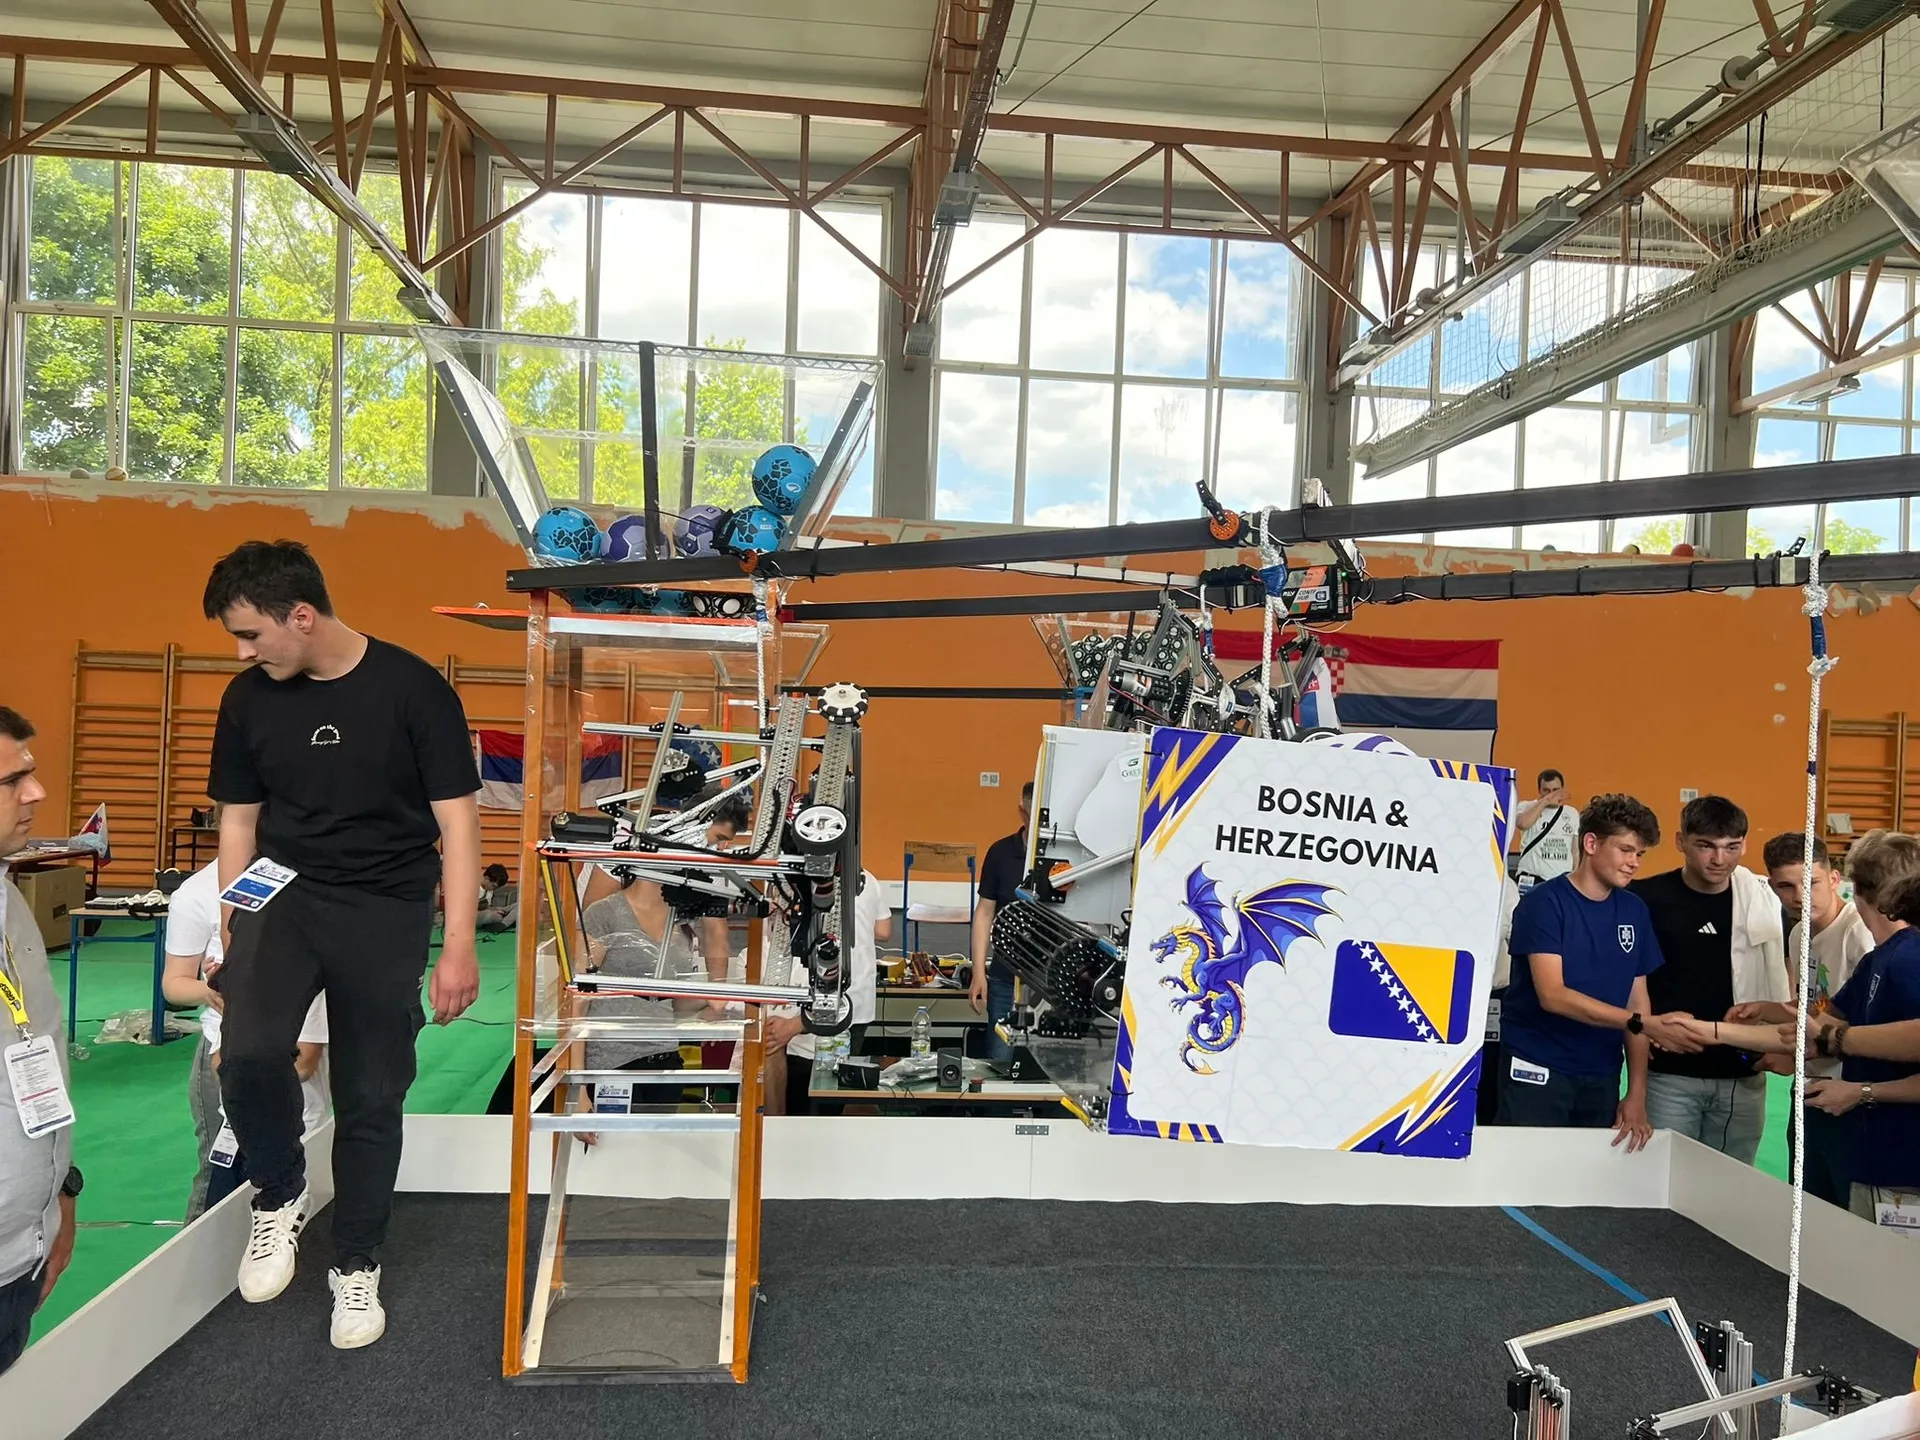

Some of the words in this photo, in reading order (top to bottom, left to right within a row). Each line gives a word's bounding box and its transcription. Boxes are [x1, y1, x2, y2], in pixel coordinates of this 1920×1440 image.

[1257, 785, 1376, 823] BOSNIA
[1385, 800, 1408, 827] &
[1215, 824, 1439, 873] HERZEGOVINA
